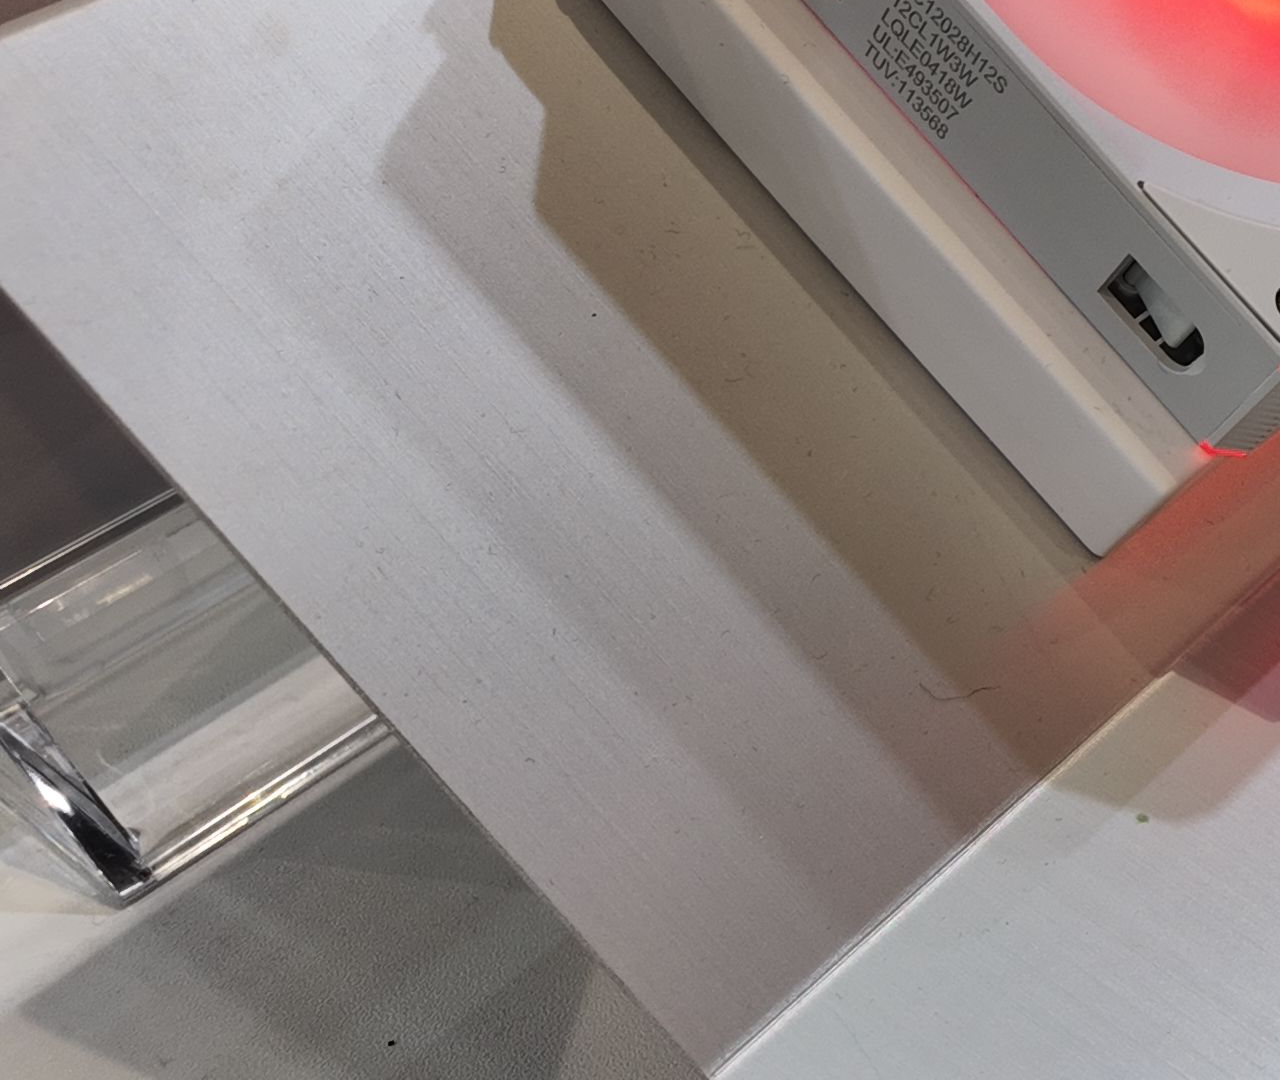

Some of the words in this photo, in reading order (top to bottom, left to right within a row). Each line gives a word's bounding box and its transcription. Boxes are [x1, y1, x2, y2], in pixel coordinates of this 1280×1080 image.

[864, 39, 949, 140] TUV:113568
[872, 24, 960, 120] UL:E493507
[881, 7, 972, 110] LQLE0418W
